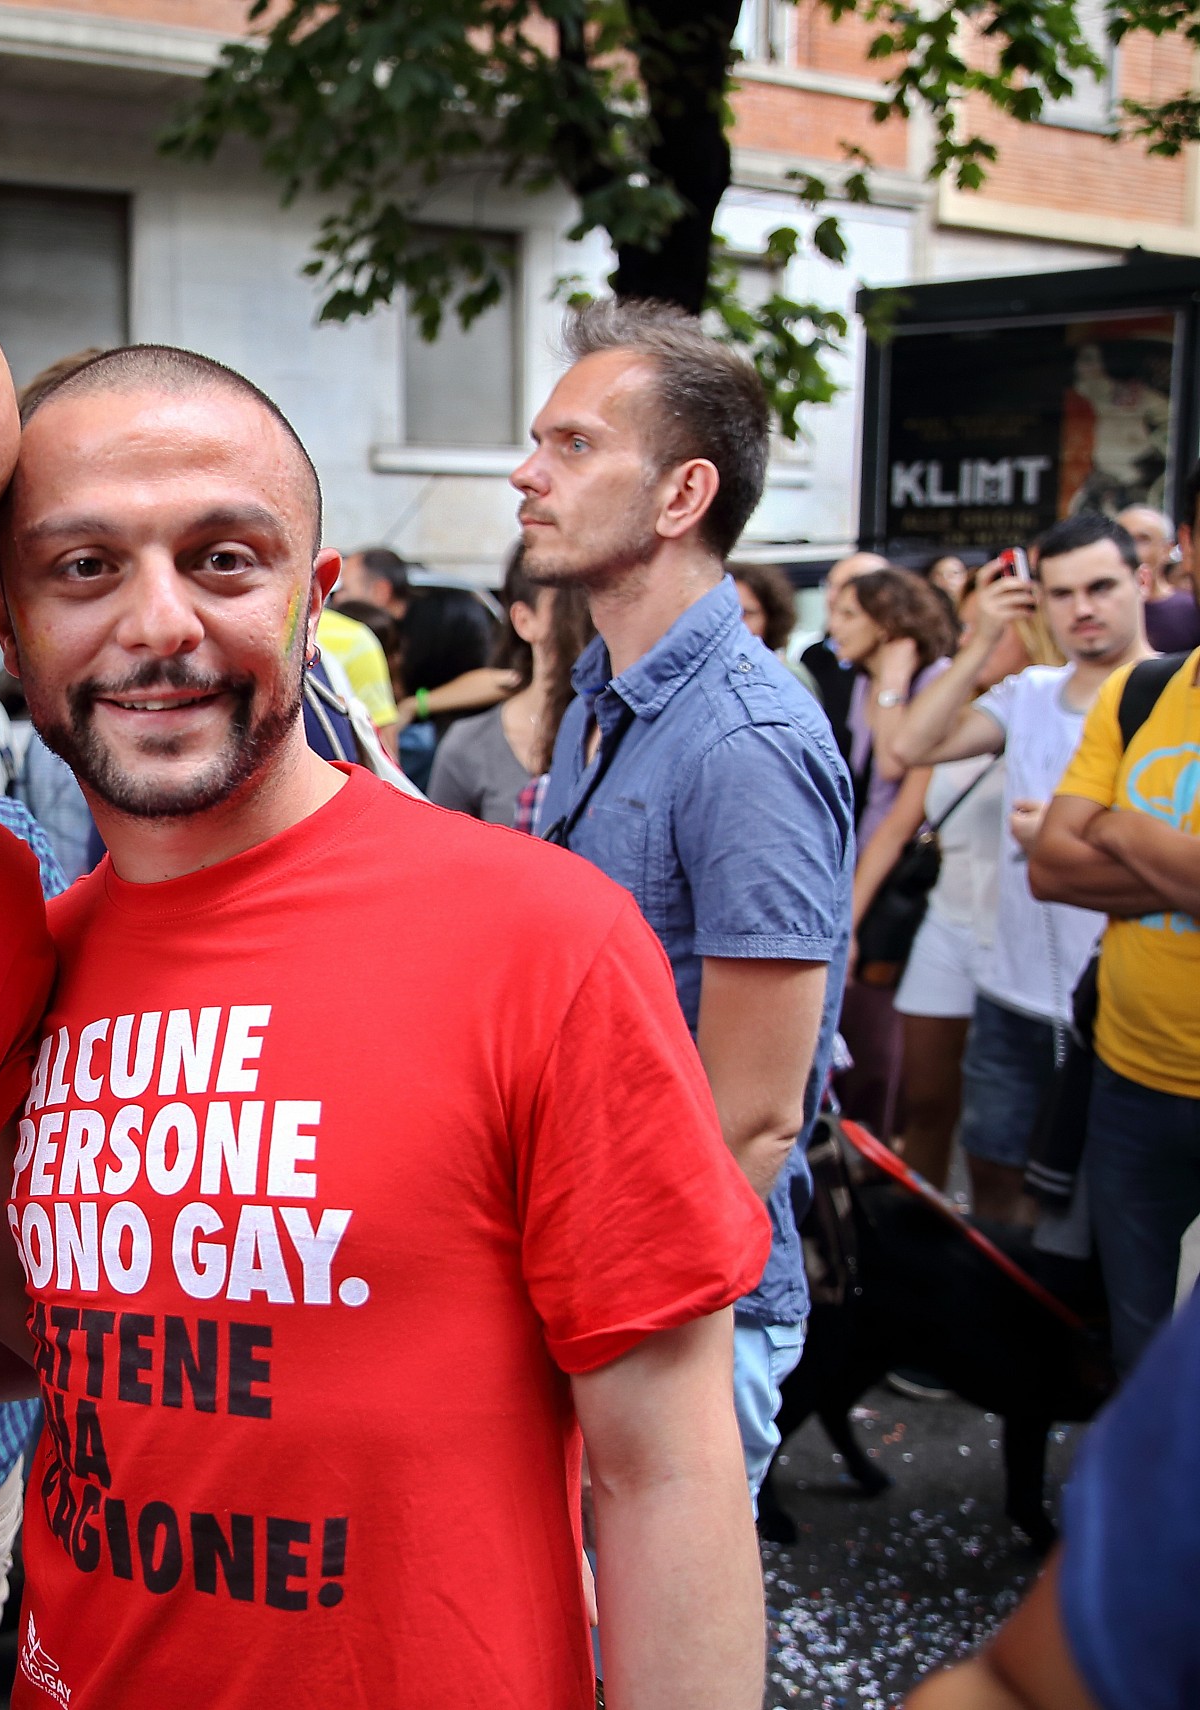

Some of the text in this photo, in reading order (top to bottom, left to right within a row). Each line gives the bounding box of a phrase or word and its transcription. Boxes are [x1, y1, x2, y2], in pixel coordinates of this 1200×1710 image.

[890, 455, 1052, 508] KLIMT
[25, 1004, 272, 1116] ALCUNE
[11, 1100, 322, 1199] PERSONE
[171, 1201, 371, 1307] GAY.
[27, 1303, 272, 1419] ATTENE
[42, 1384, 112, 1491] NA
